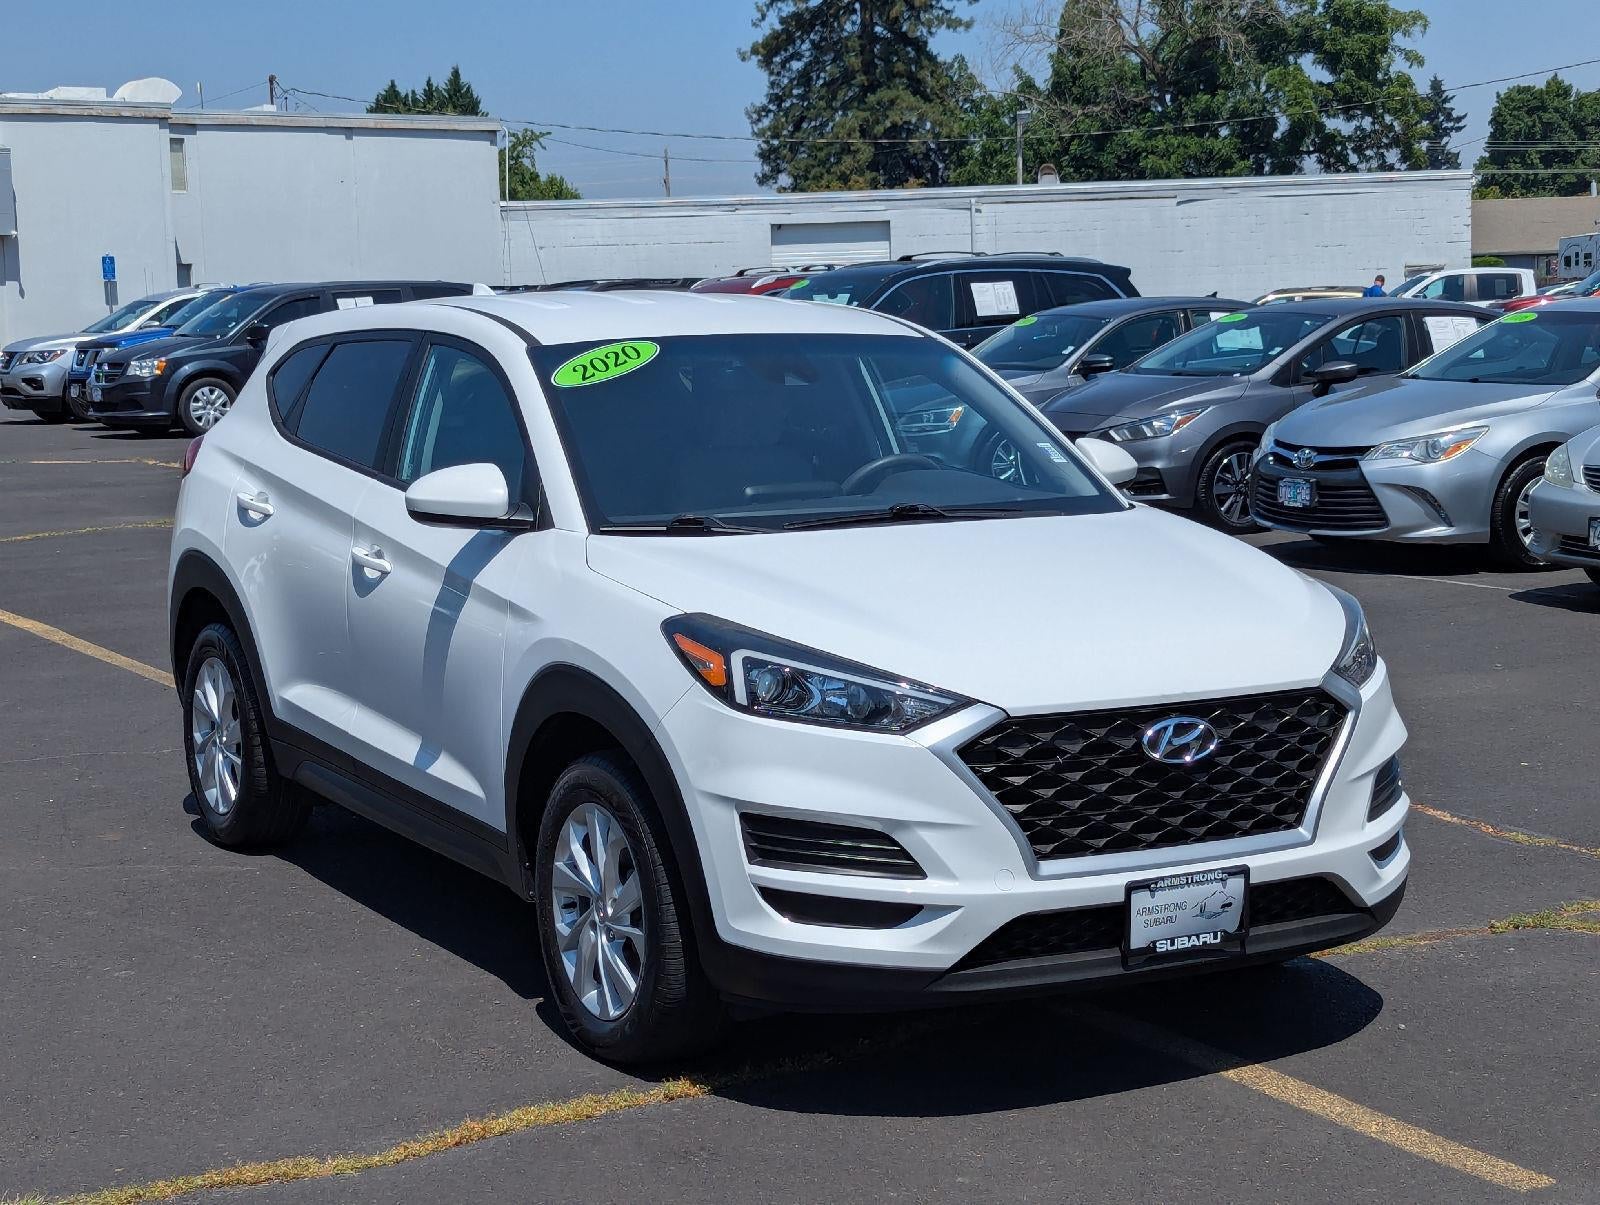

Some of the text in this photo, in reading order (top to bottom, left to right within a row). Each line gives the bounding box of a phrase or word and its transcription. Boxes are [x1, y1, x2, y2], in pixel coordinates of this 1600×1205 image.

[572, 345, 641, 381] 2020
[1156, 870, 1223, 889] ARMSTRONG
[1136, 900, 1188, 918] ARMSTRONG
[1143, 915, 1178, 929] SUBARU
[1156, 931, 1221, 952] SUBARU
